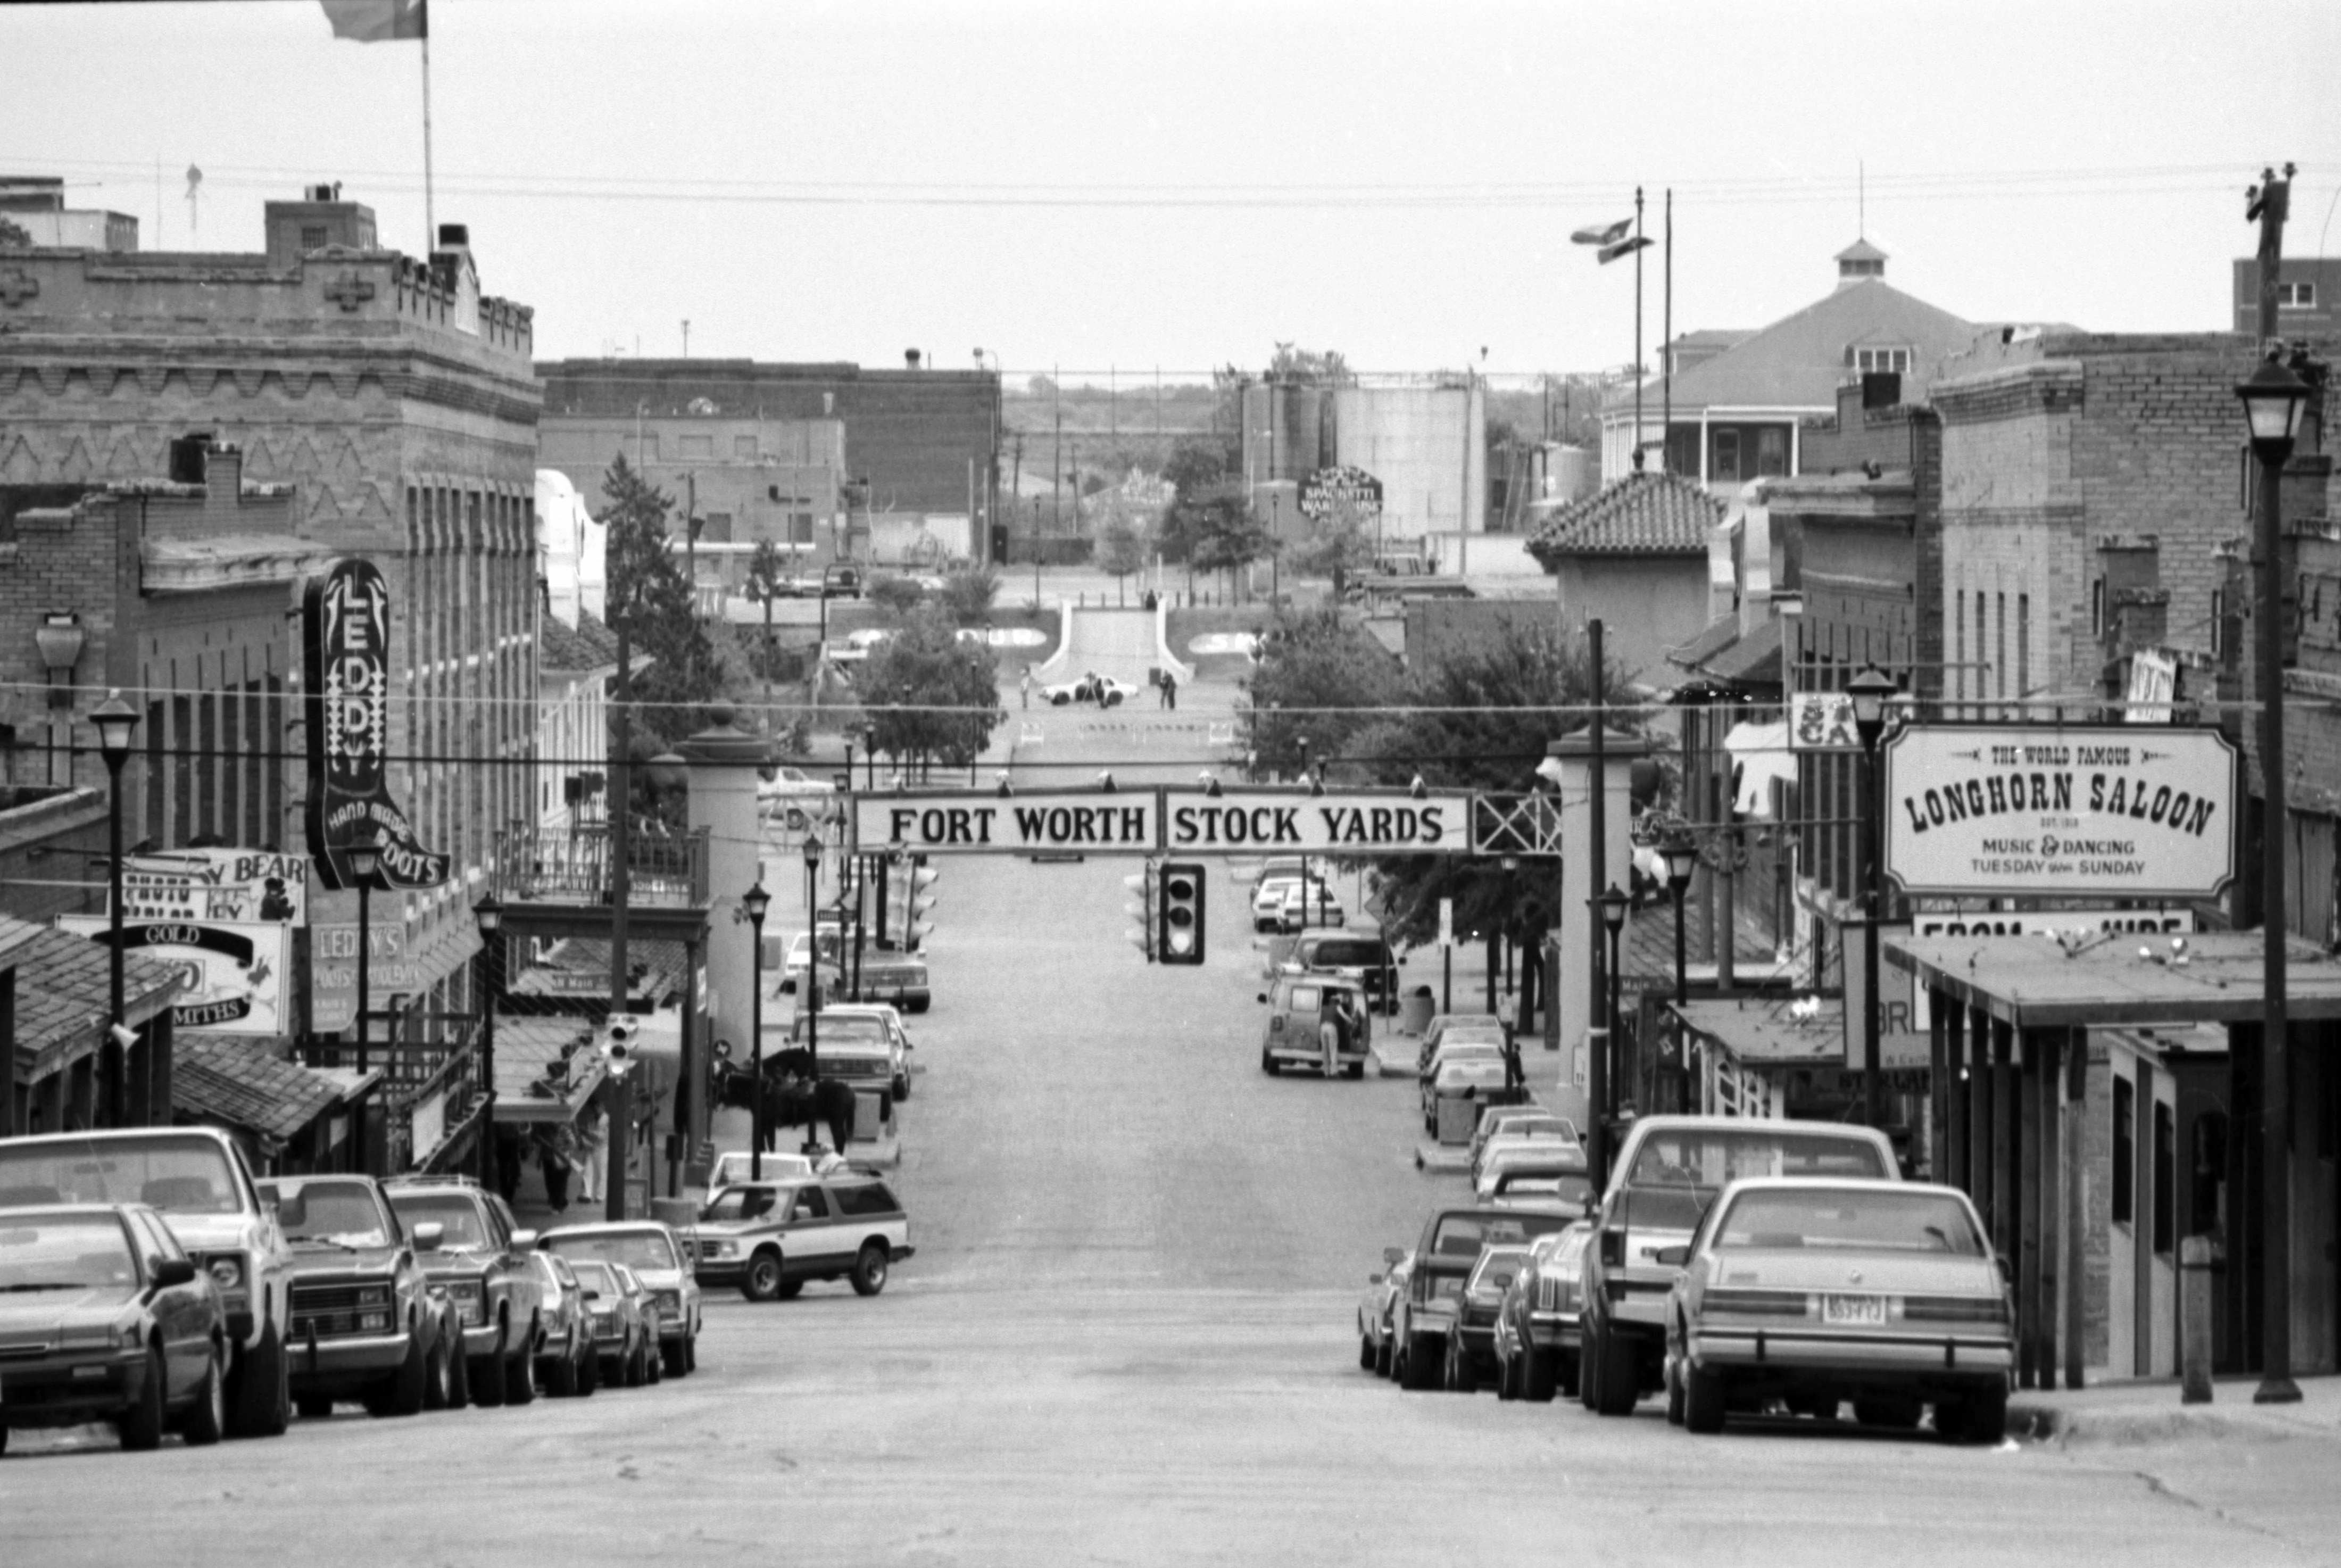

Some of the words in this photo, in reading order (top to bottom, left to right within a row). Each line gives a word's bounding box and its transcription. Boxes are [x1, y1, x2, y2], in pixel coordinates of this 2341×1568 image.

[343, 574, 371, 777] LEDDY
[1991, 745, 2018, 766] THE
[2024, 745, 2070, 766] WORLD
[2077, 745, 2130, 766] FAMOUS
[1905, 773, 2072, 834] LONGHORN
[2089, 773, 2216, 837] SALOON
[328, 800, 367, 829] HAND
[369, 802, 413, 843] MADE
[889, 808, 997, 843] FORT
[1013, 807, 1146, 842] WORTH
[1174, 807, 1302, 843] STOCK
[1319, 807, 1443, 843] YARDS
[374, 826, 442, 884] BOOTS
[1982, 839, 2035, 854] MUSIC
[2041, 834, 2059, 858] &
[2063, 839, 2135, 855] DANCING
[235, 854, 304, 884] BEAR
[1971, 859, 2045, 874] TUESDAY
[2079, 859, 2146, 875] SUNDAY
[146, 925, 201, 943] GOLD
[320, 927, 398, 957] LEDY'S
[173, 1001, 240, 1025] MITHS
